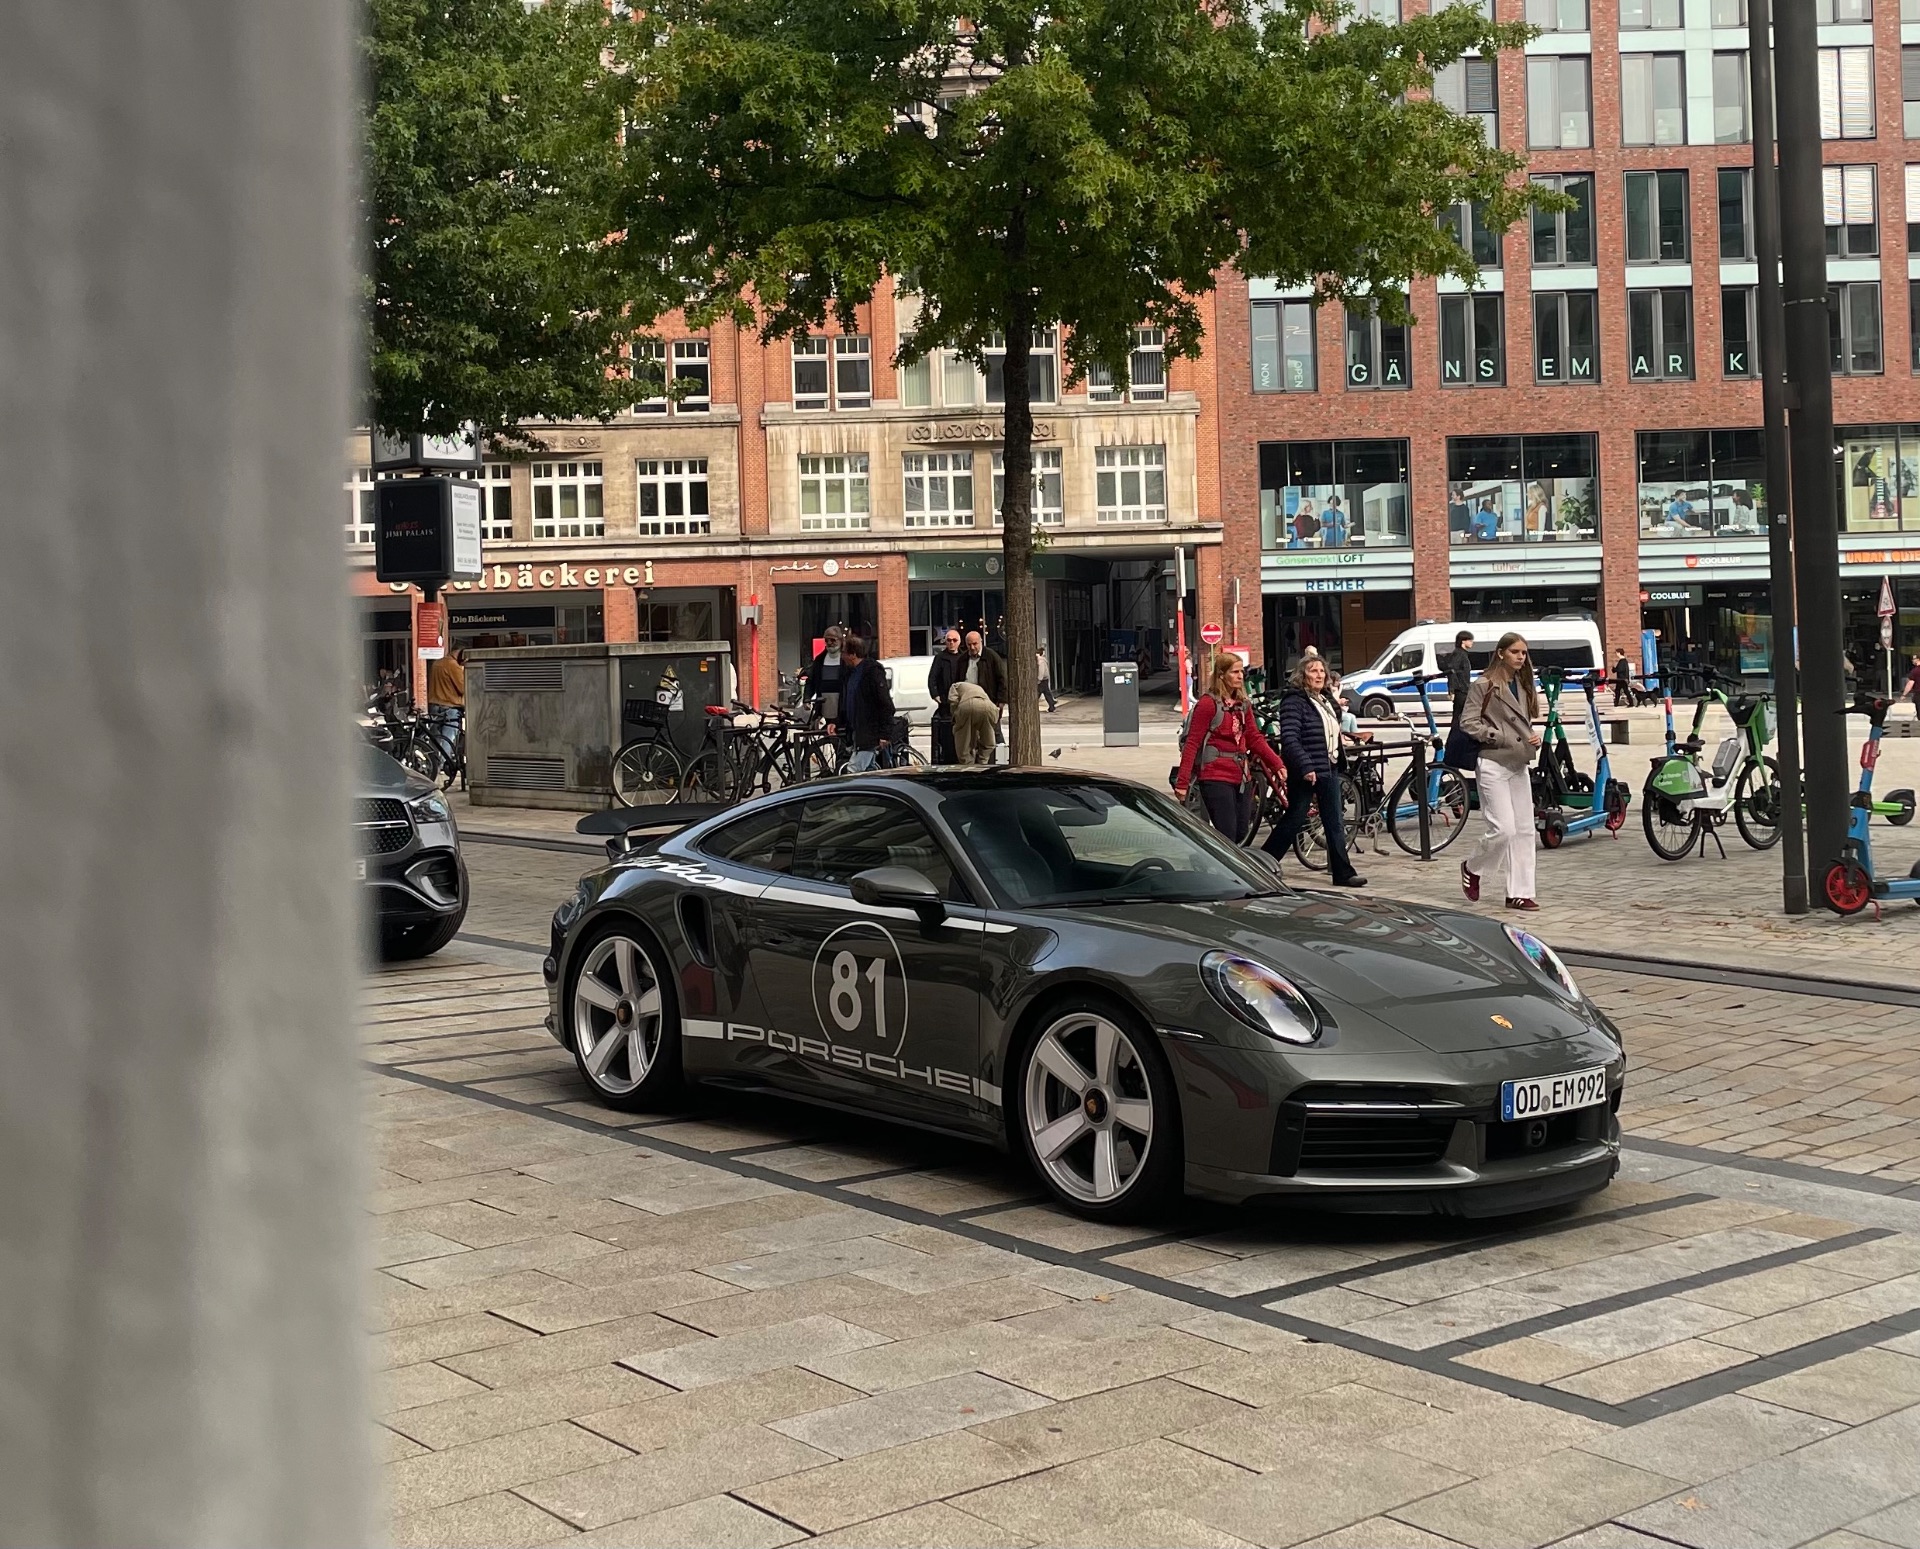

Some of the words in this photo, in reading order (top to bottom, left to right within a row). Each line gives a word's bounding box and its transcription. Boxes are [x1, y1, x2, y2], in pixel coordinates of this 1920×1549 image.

[1261, 363, 1270, 387] NOW
[1293, 361, 1303, 388] OPEN
[406, 528, 434, 537] PALAIS
[1699, 556, 1741, 565] COOLBLUE
[390, 561, 655, 591] tbäckerei
[1650, 591, 1691, 600] COOLBLUE
[452, 615, 467, 624] Die
[829, 950, 887, 1038] 81
[727, 1023, 972, 1094] PORSCHE
[1516, 1084, 1541, 1115] OD
